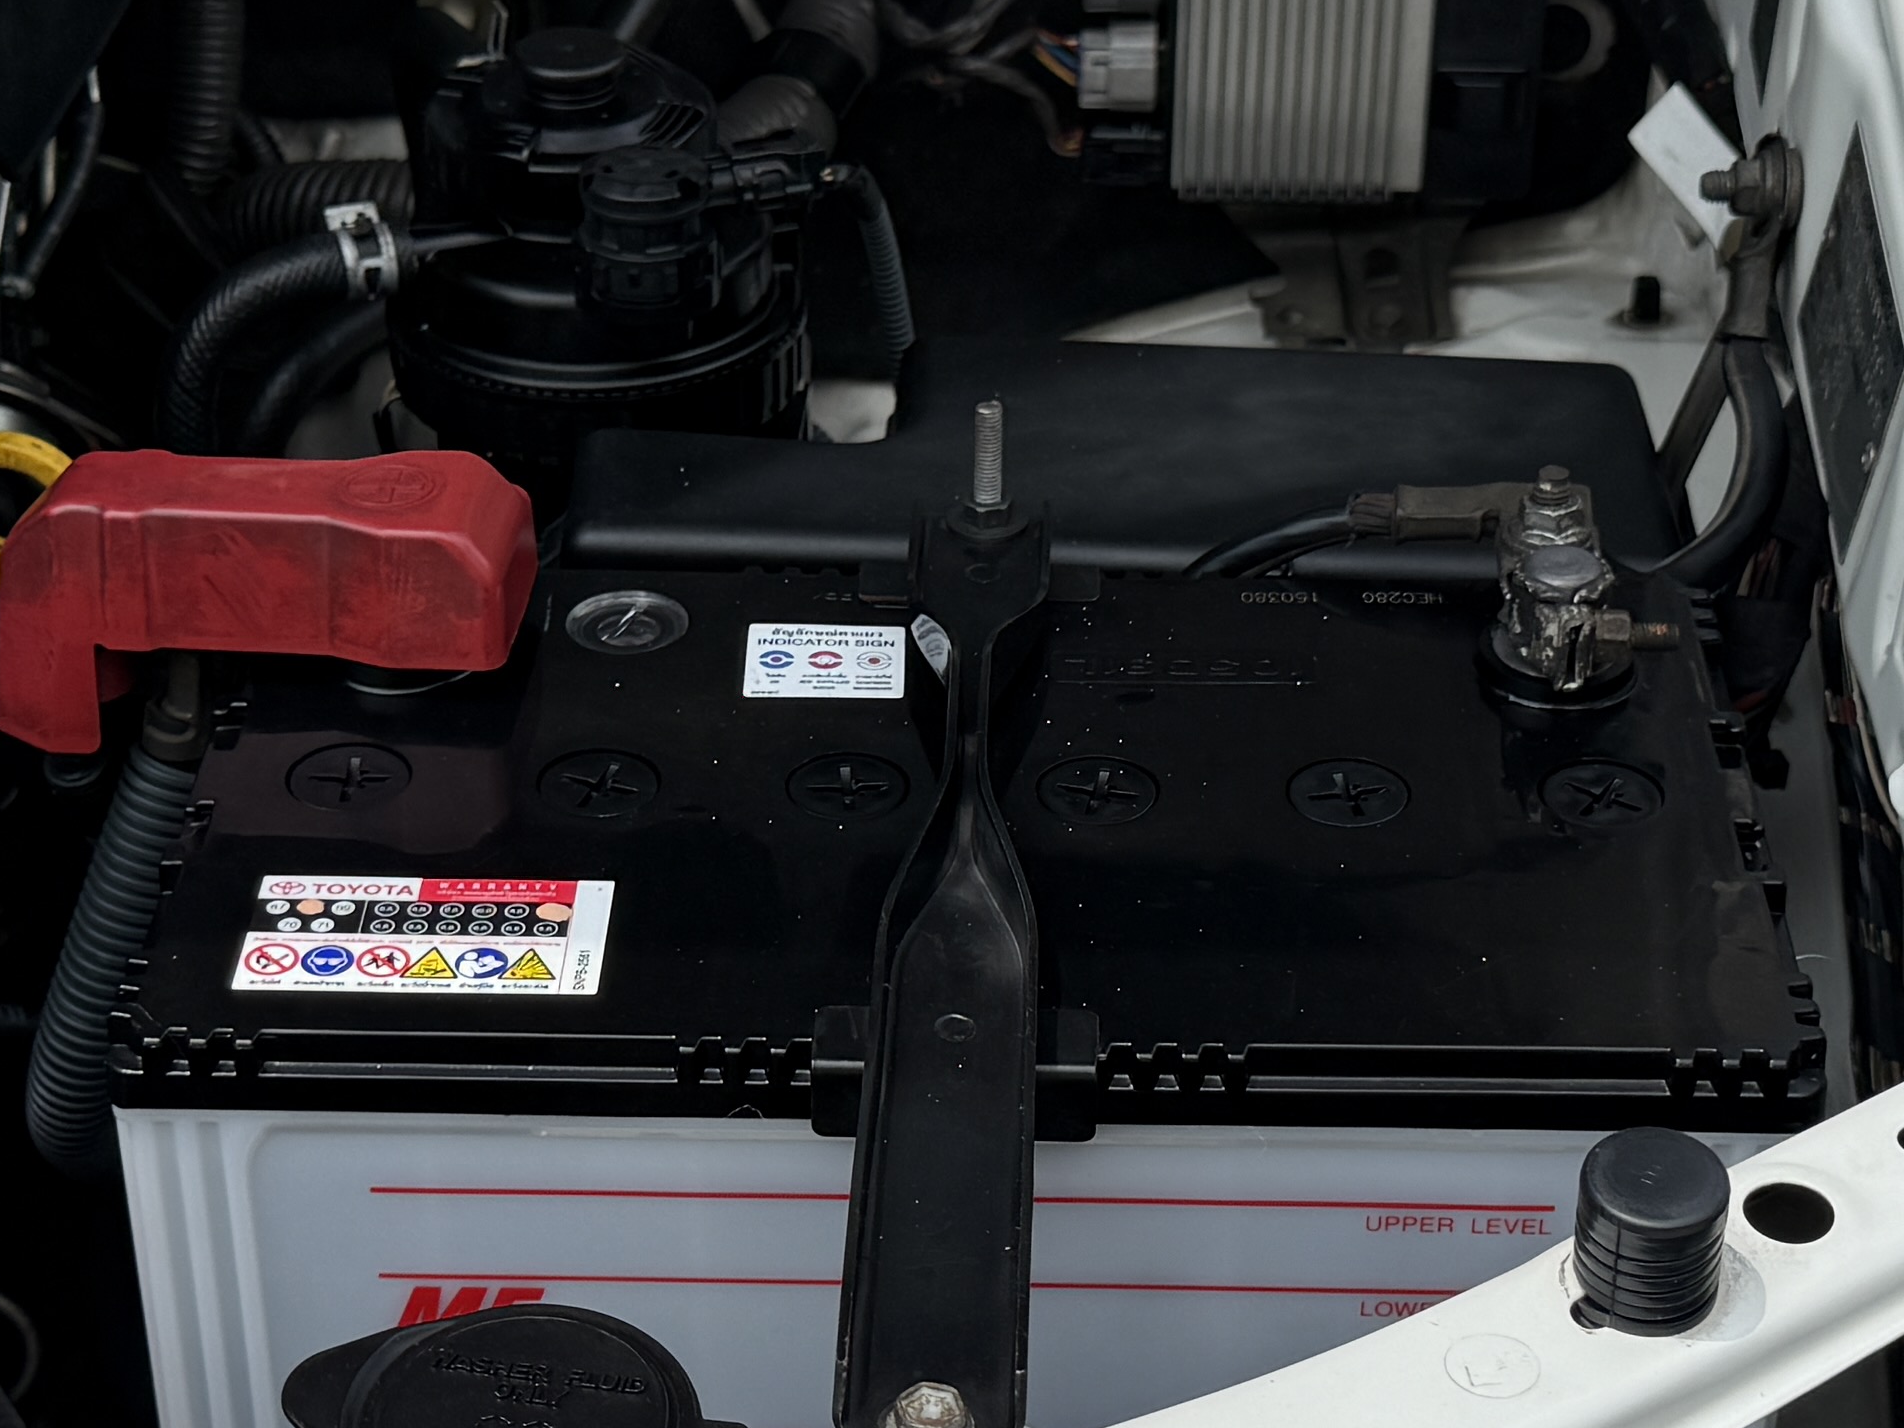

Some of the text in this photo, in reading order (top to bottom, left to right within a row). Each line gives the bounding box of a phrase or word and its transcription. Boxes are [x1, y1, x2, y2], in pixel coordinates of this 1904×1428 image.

[757, 638, 895, 648] INDICATOR SIGN
[312, 883, 414, 896] TOYOTA
[1365, 1215, 1552, 1235] UPPER LEVEL
[566, 1368, 646, 1395] FLUID
